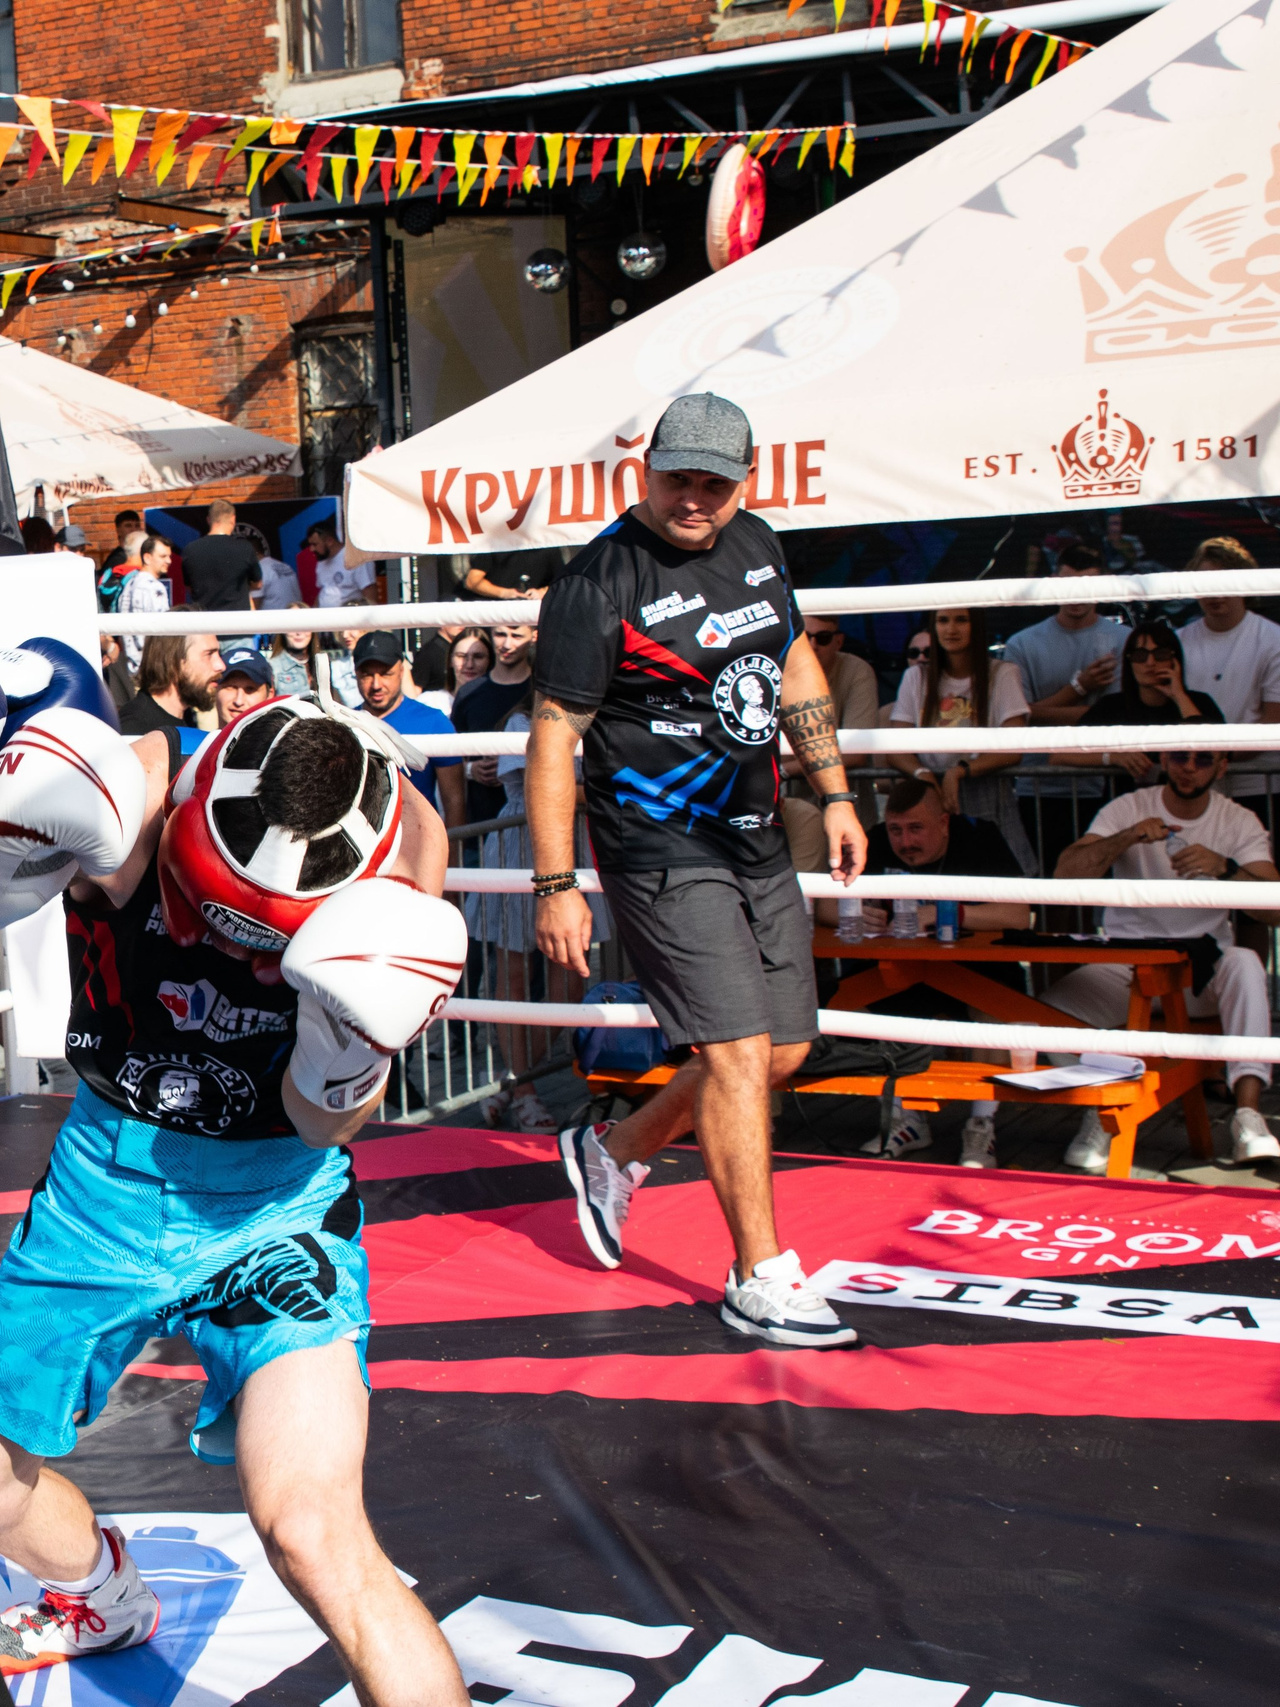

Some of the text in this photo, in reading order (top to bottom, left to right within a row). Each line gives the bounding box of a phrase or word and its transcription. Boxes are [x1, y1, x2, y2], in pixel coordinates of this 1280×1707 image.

[1173, 434, 1258, 462] 1581
[965, 453, 1037, 479] EST.
[205, 905, 288, 950] LEADERS
[225, 910, 276, 937] PROFESSIONAL
[1020, 1247, 1141, 1268] GIN
[835, 1272, 1260, 1329] SIBSA
